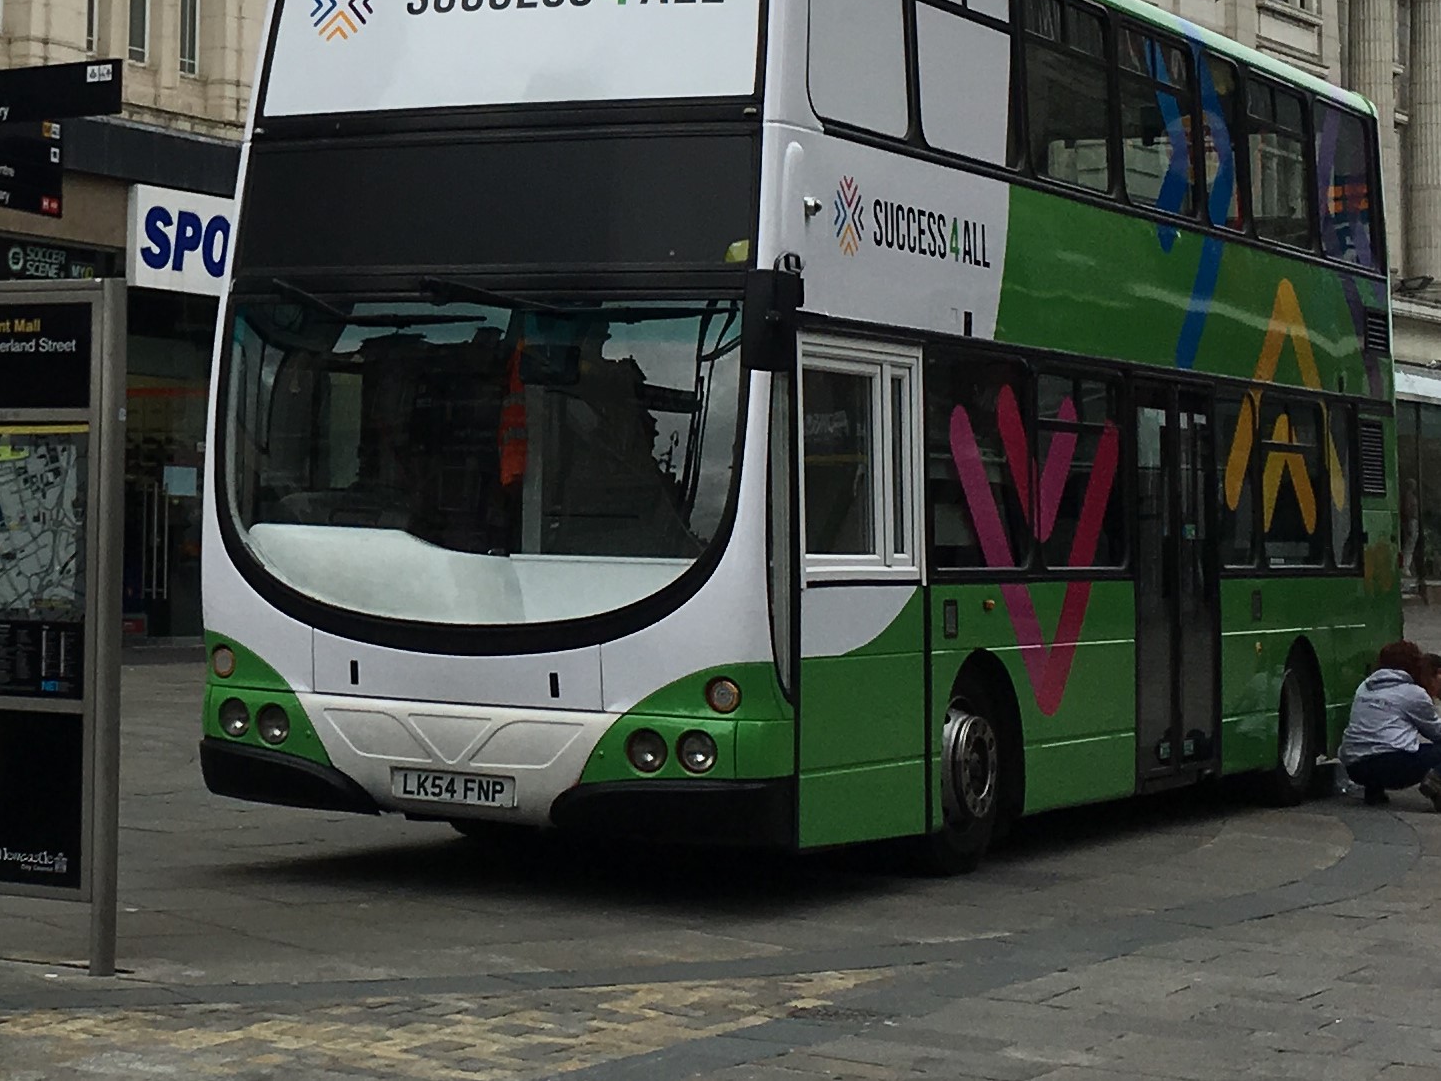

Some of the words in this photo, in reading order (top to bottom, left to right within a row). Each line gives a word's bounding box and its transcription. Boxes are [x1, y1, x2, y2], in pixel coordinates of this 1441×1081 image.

[140, 205, 231, 278] SPO
[26, 246, 67, 264] SOCCER
[26, 261, 60, 278] SCENE
[14, 319, 41, 332] Mall
[38, 337, 76, 352] Street
[403, 773, 457, 799] LK54
[463, 778, 505, 802] FNP
